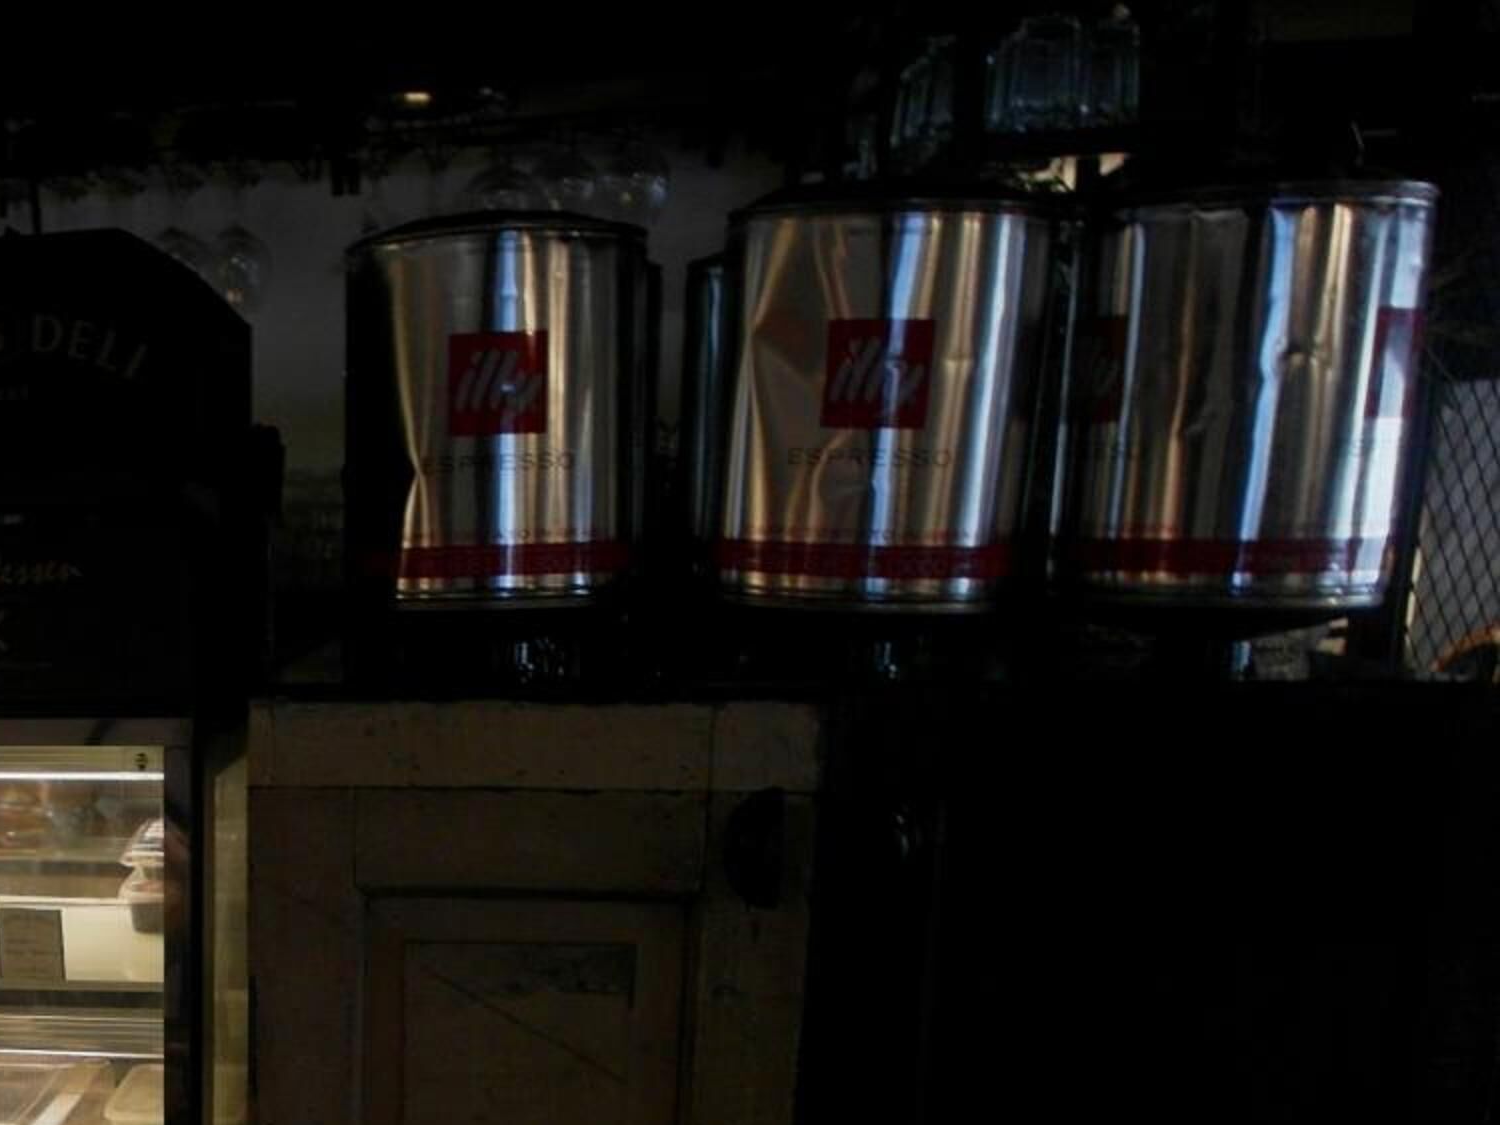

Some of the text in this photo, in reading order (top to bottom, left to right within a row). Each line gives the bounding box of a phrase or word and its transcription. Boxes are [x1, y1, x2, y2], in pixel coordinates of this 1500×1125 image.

[31, 312, 149, 381] DELI
[828, 334, 925, 424] illy
[454, 347, 543, 427] illy
[786, 447, 952, 467] ESPRESSO
